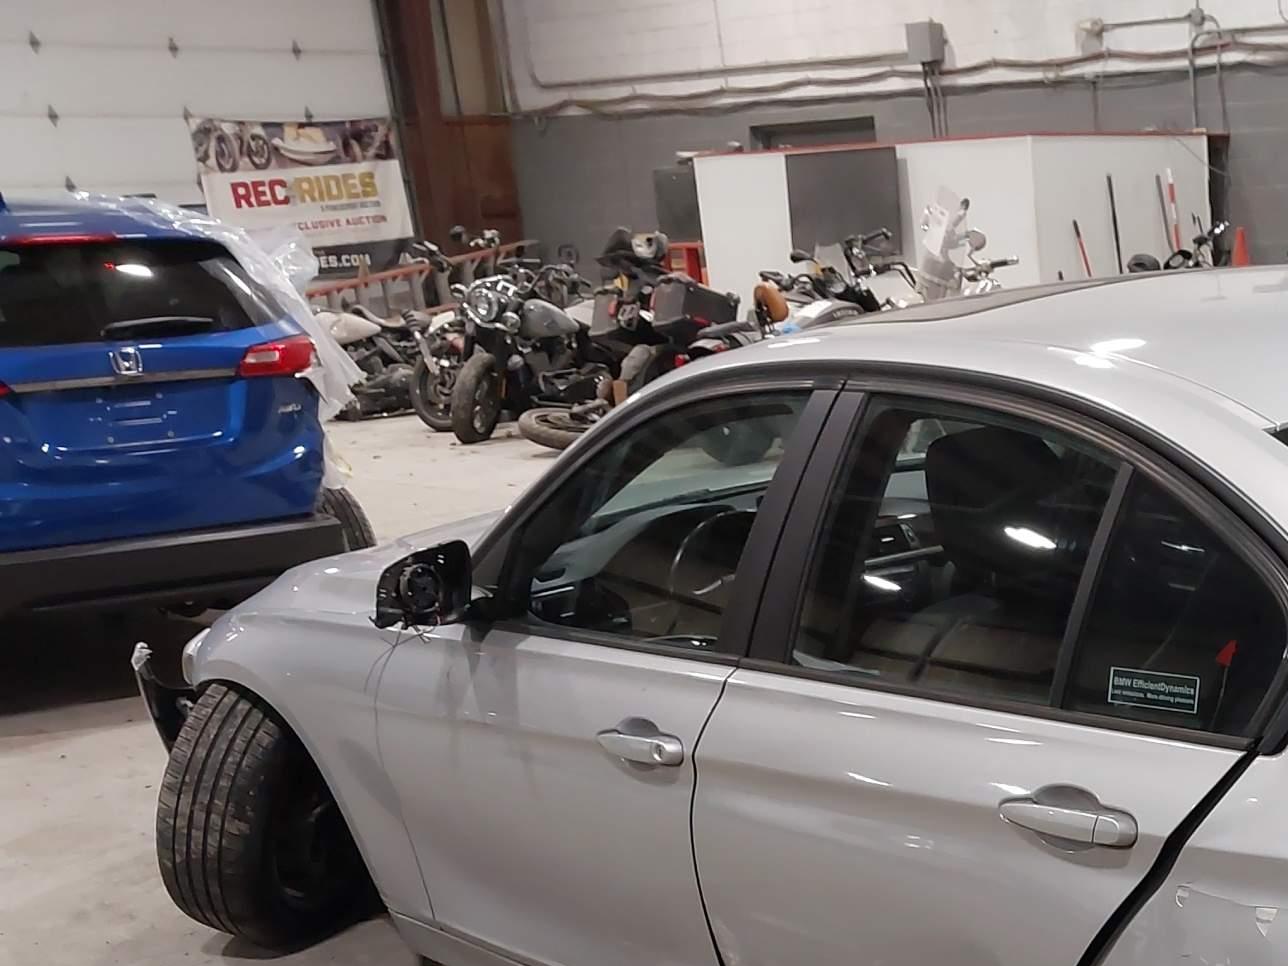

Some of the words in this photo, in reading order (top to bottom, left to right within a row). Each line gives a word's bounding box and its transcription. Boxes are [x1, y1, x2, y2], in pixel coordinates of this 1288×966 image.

[230, 179, 290, 209] REC
[294, 172, 378, 204] RIDES
[296, 217, 342, 231] CLUSIVE
[345, 214, 388, 226] AUCTION
[319, 253, 371, 269] ES.COM
